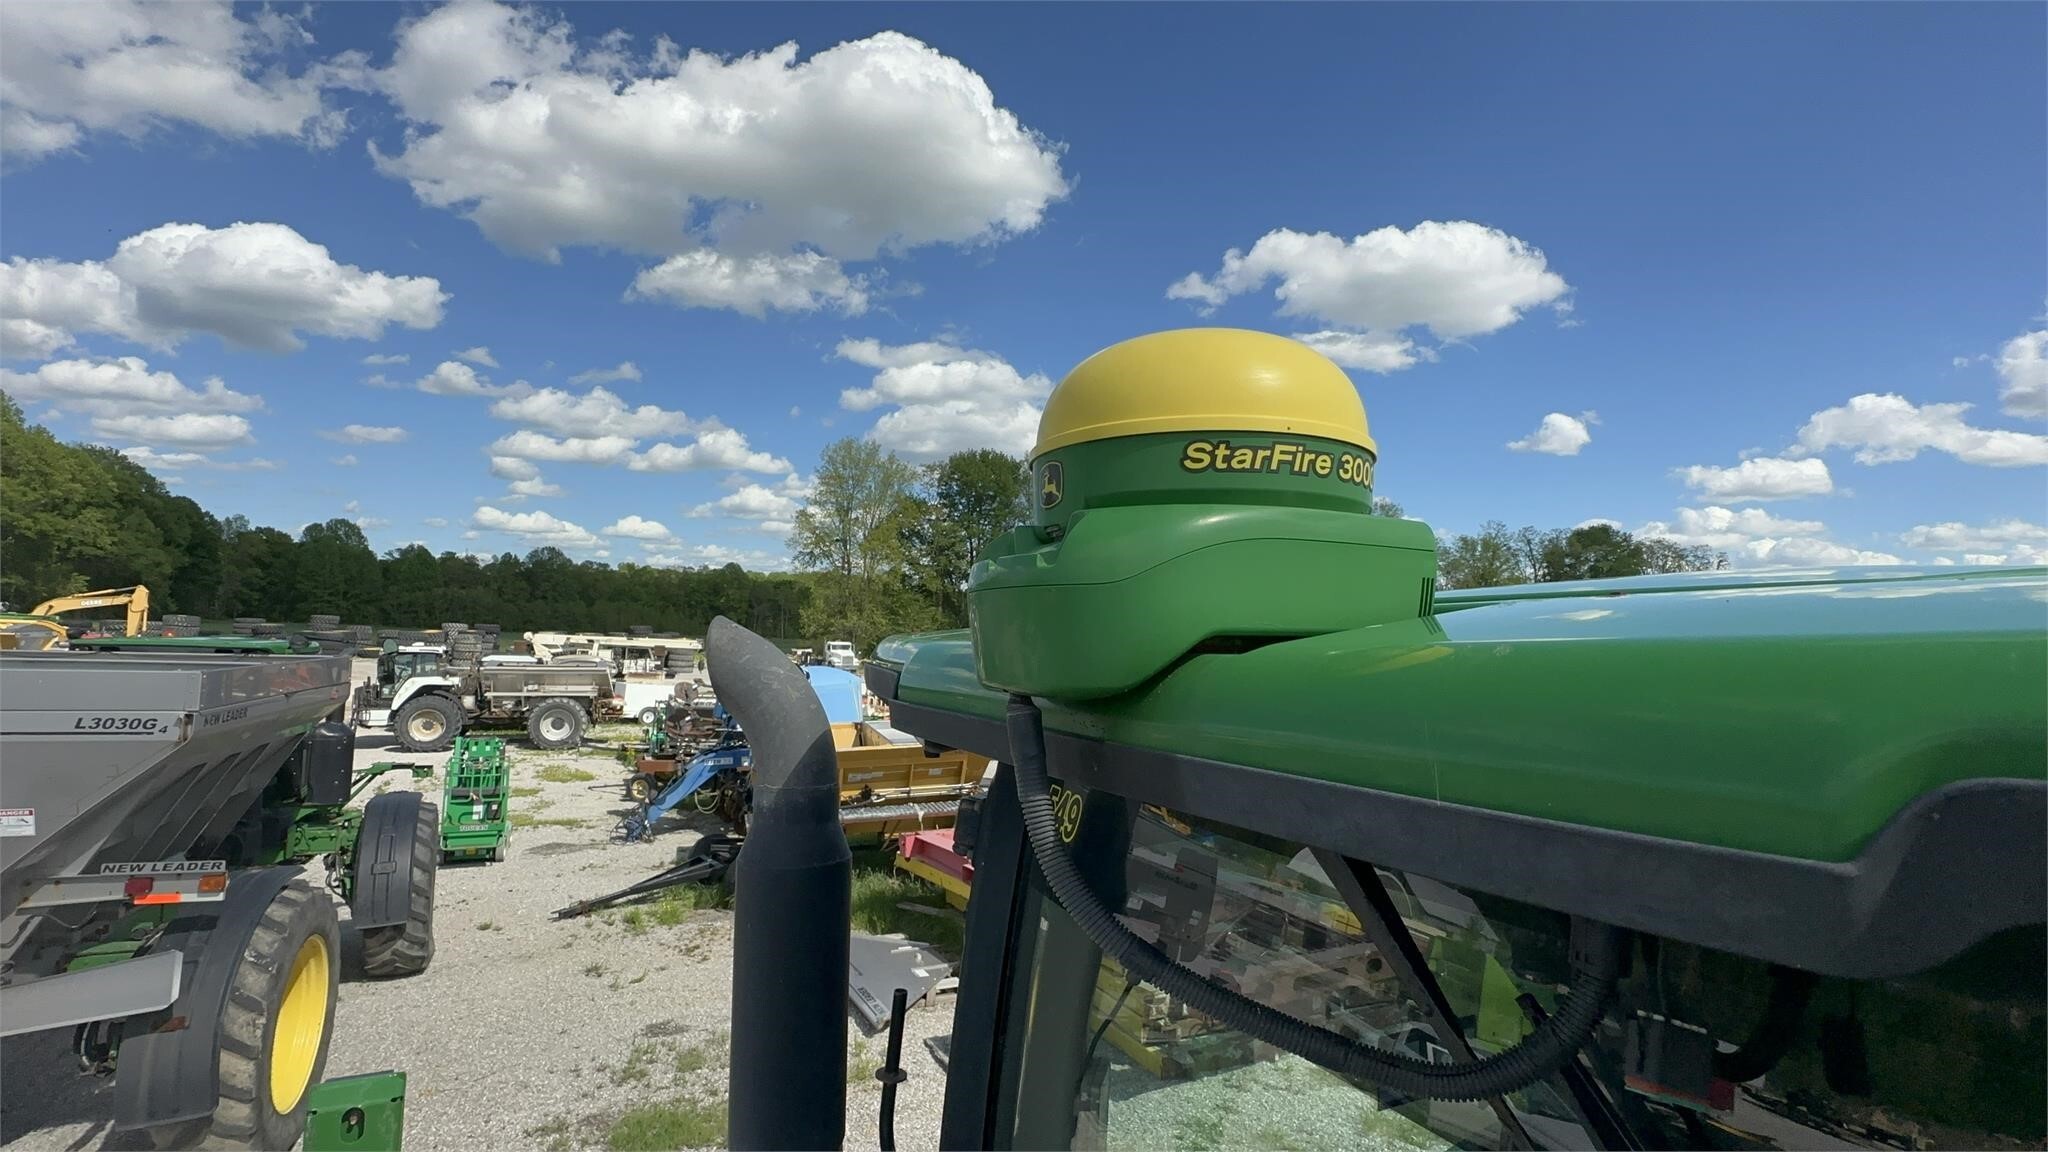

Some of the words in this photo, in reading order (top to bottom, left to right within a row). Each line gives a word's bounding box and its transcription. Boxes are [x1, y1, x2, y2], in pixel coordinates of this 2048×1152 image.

[1183, 441, 1333, 479] StarFire
[221, 707, 249, 724] LEADER
[102, 863, 146, 873] NEW
[150, 861, 223, 872] LEADER
